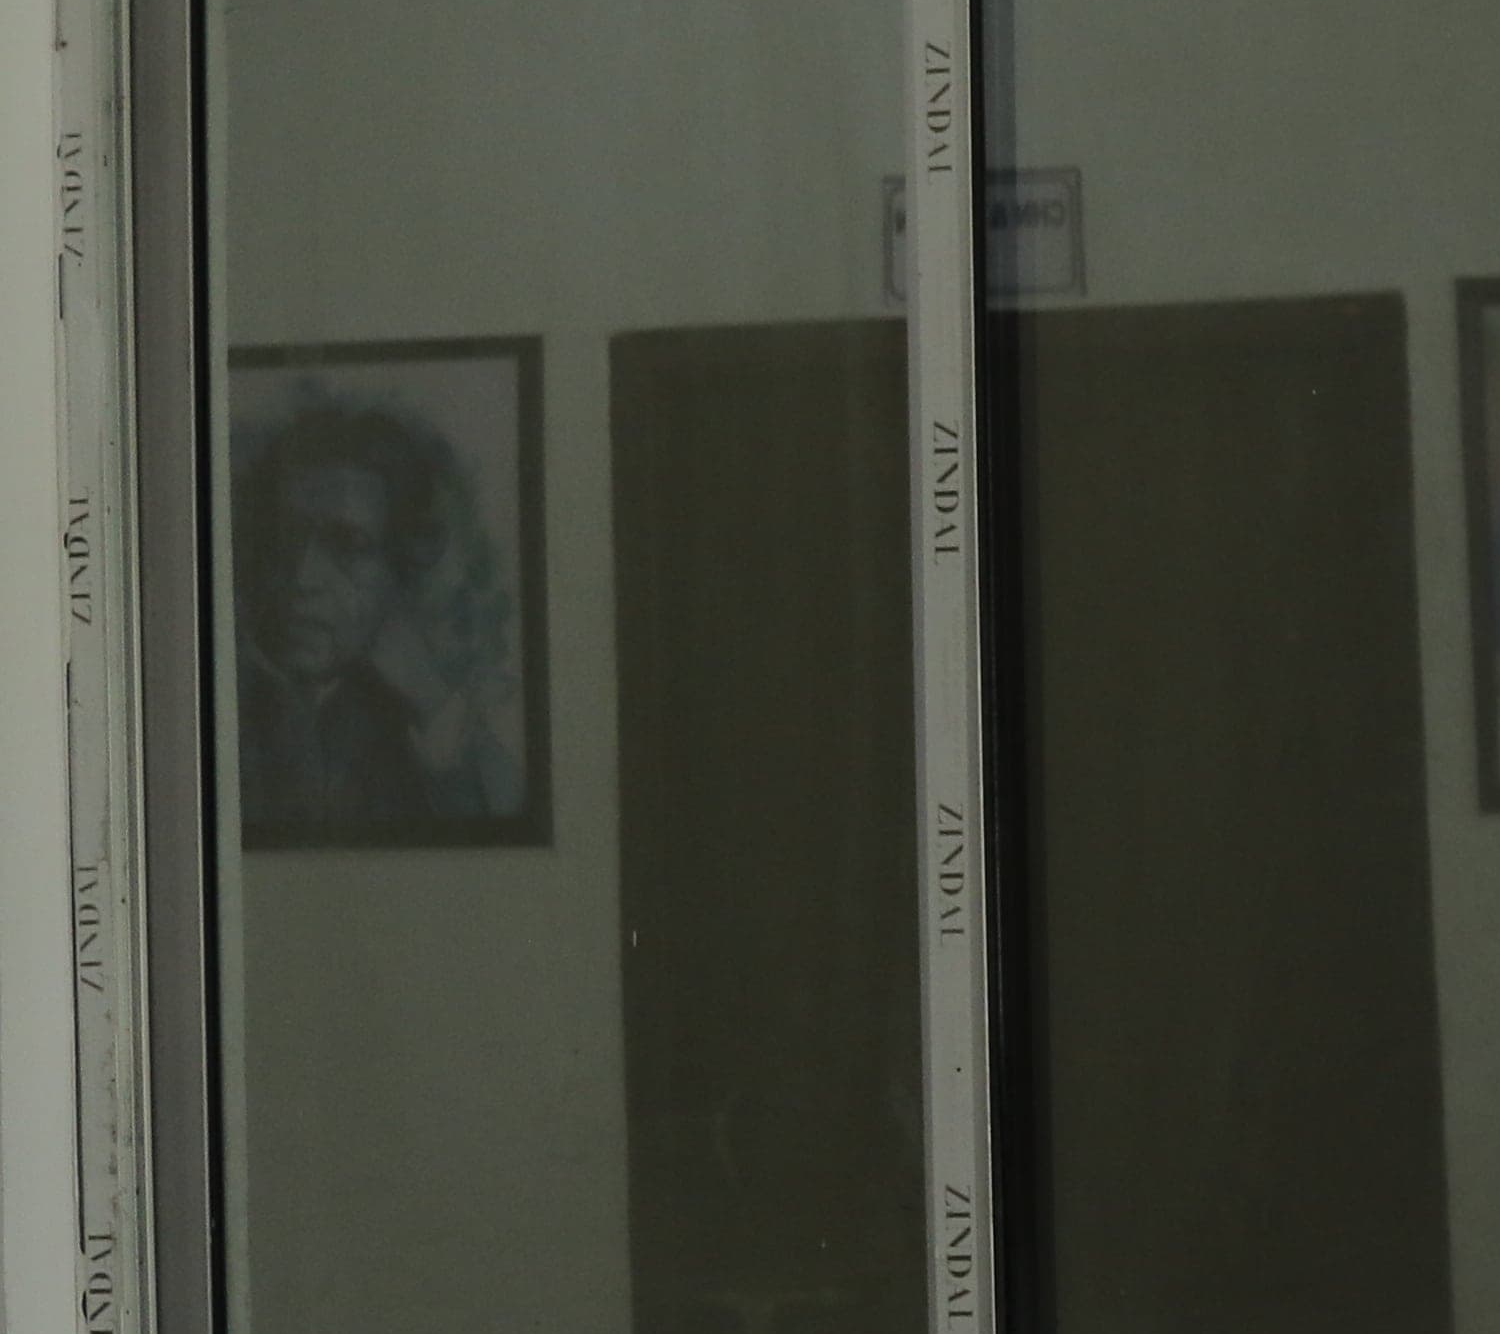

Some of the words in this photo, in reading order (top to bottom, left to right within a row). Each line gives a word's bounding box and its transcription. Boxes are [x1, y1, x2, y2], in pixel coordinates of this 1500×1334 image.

[924, 40, 953, 185] ZINDAL
[68, 489, 96, 627] ZINDAL
[932, 419, 960, 566] ZINDAL
[937, 802, 966, 948] ZINDAL
[944, 1183, 974, 1331] ZINDAL
